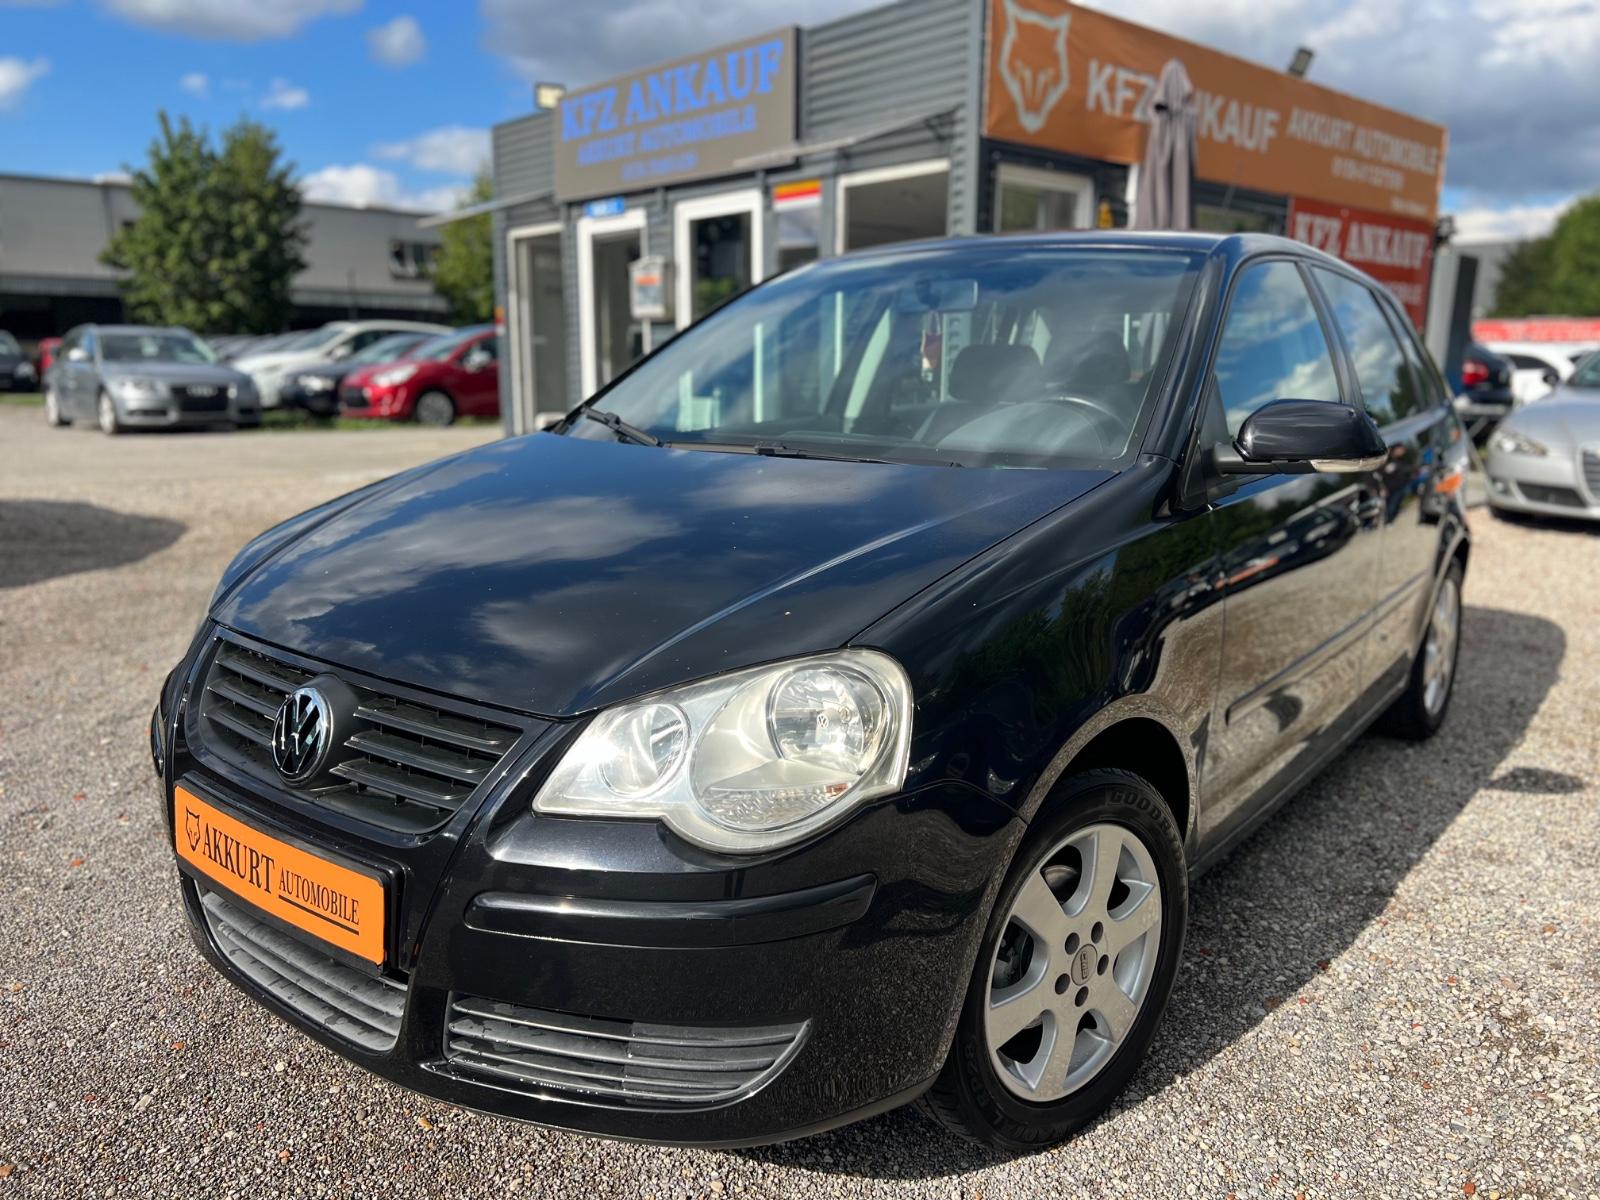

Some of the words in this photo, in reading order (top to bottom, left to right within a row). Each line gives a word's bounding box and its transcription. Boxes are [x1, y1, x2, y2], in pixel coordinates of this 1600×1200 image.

[560, 86, 619, 142] KFZ
[624, 39, 785, 127] ANKAUF
[1087, 57, 1157, 123] KFZ
[1194, 88, 1281, 155] KAUF
[1286, 106, 1353, 151] AKKURT
[1353, 125, 1439, 176] AUTOMOBILE
[1294, 212, 1343, 259] KFZ
[1344, 221, 1427, 271] ANKAUF
[202, 822, 275, 894] AKKURT
[278, 866, 360, 926] AUTOMOBILE
